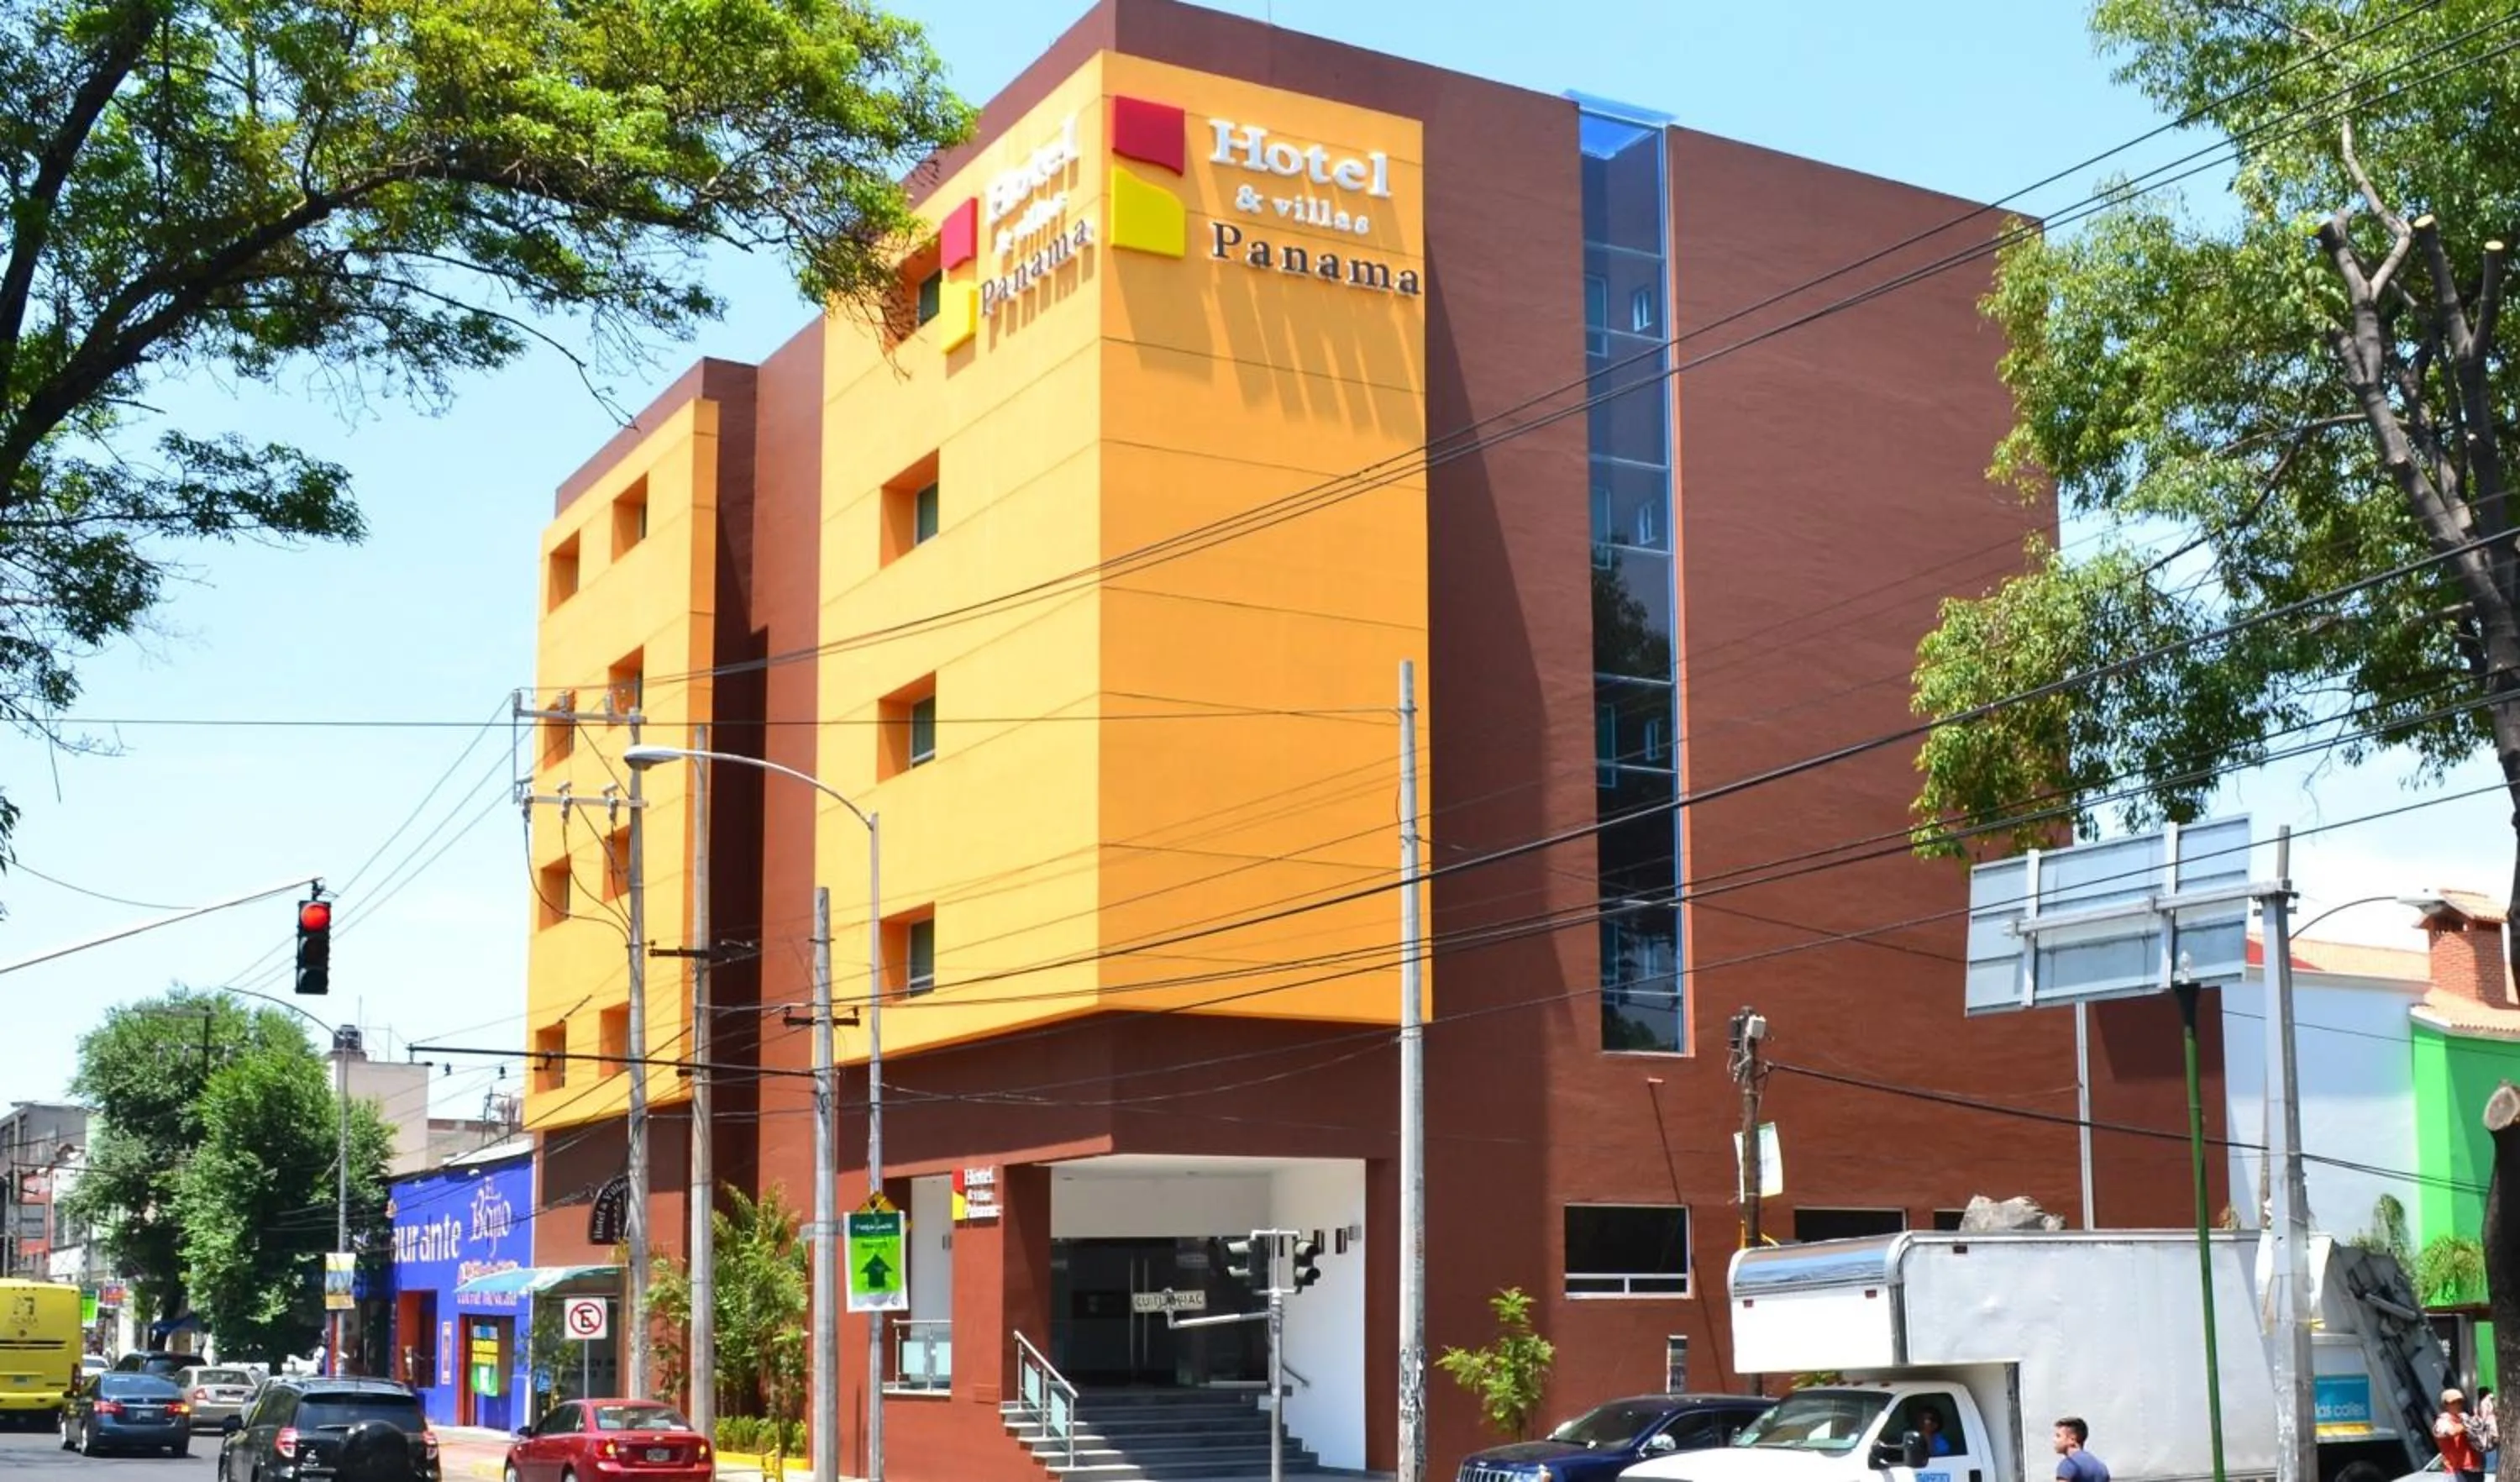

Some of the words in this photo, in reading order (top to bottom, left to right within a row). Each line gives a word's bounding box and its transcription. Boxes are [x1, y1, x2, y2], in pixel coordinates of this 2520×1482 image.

[1209, 118, 1392, 198] Hotel
[1235, 183, 1264, 214] &
[1271, 194, 1371, 235] villas
[979, 218, 1094, 318] Panama
[1208, 220, 1422, 297] Panama
